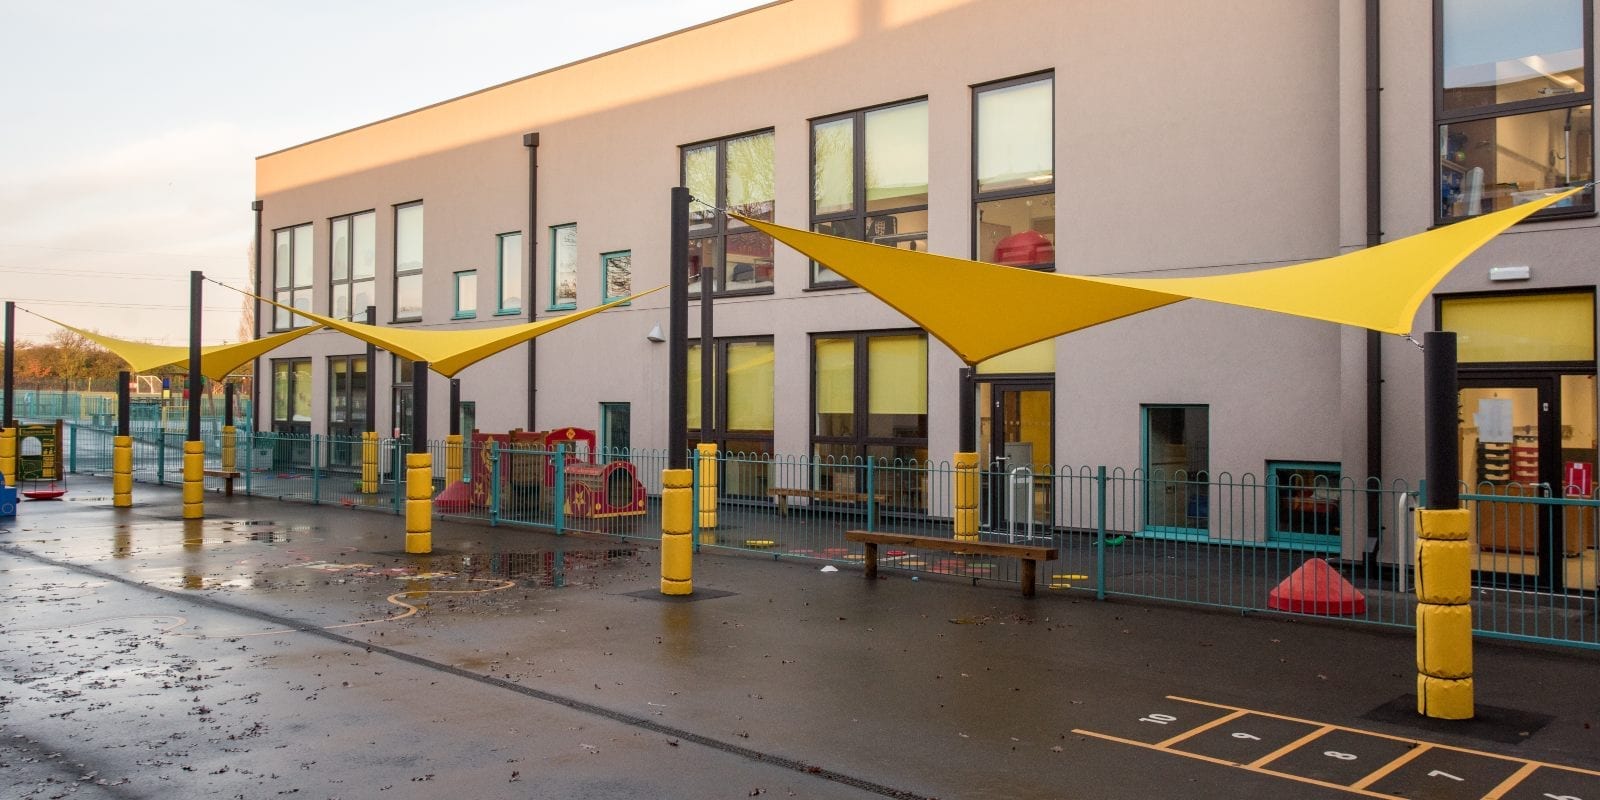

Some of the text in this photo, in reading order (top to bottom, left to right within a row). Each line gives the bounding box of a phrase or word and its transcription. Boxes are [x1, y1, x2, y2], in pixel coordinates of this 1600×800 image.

[1139, 713, 1177, 725] 10
[1231, 732, 1262, 741] 9
[1323, 750, 1358, 761] 8
[1427, 769, 1465, 781] 7
